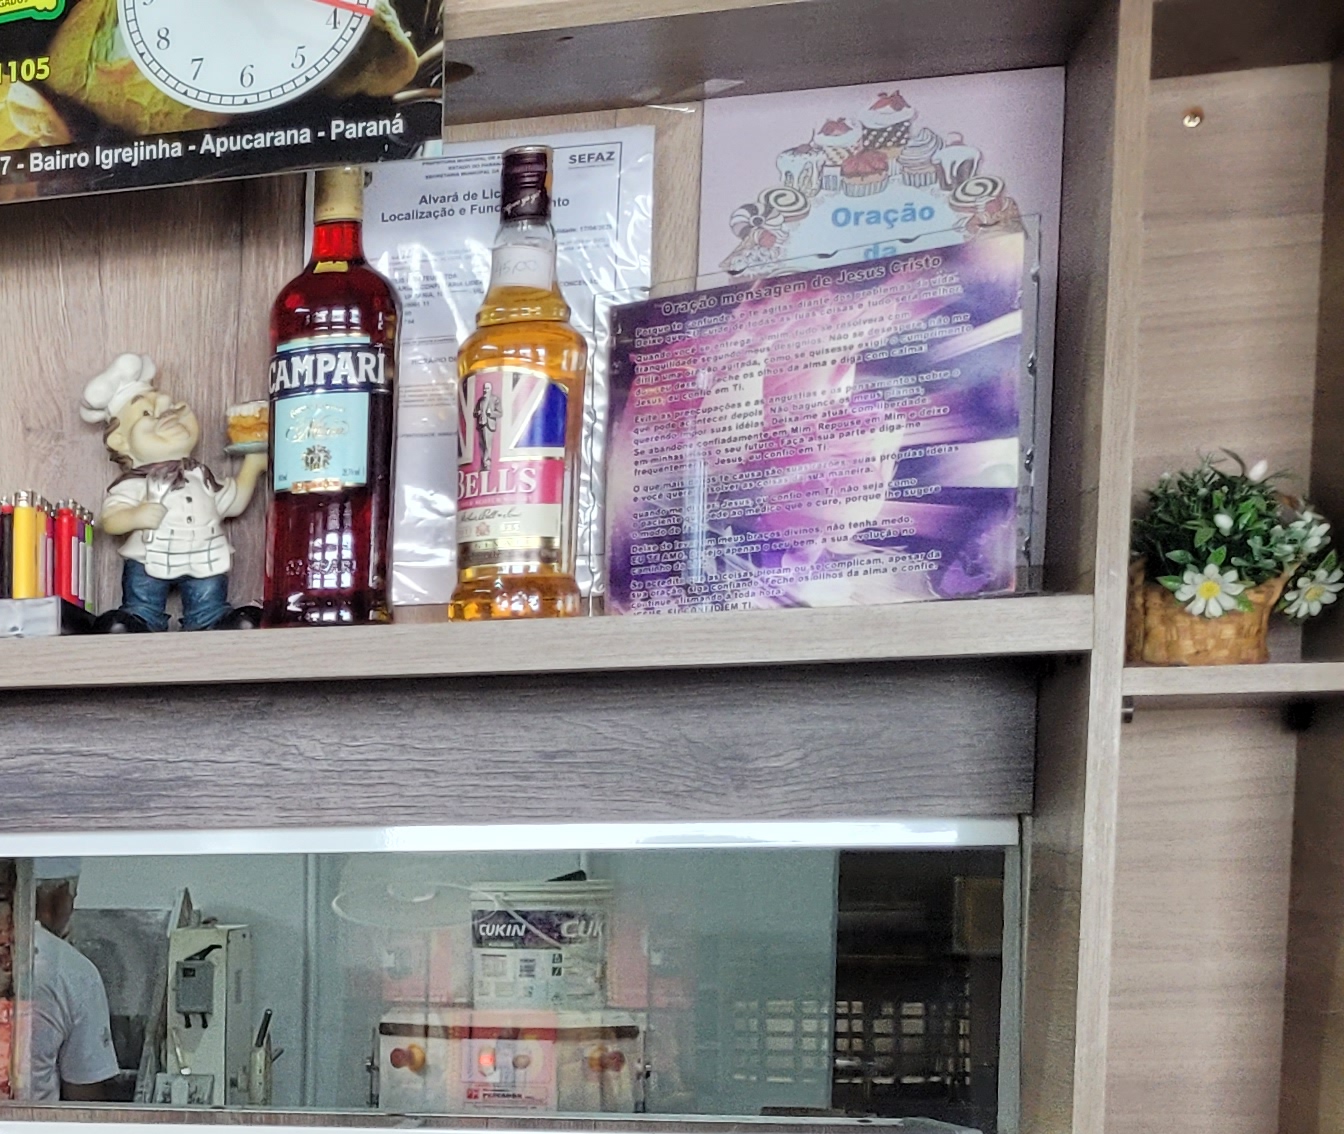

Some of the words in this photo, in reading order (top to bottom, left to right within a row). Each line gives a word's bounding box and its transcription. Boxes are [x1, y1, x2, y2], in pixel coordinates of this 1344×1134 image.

[324, 7, 341, 30] 4
[156, 26, 171, 50] 8
[290, 45, 307, 70] 5
[190, 57, 204, 81] 7
[239, 64, 255, 88] 6
[29, 149, 90, 173] Bairro
[95, 139, 182, 170] Igrejinha
[199, 125, 311, 157] Apucarana
[330, 112, 405, 140] Paraná
[568, 151, 616, 165] SEFAZ
[419, 191, 459, 206] Alvará
[463, 191, 478, 201] de
[381, 206, 455, 223] Localização
[831, 202, 935, 229] Oração
[864, 243, 897, 260] da
[662, 293, 716, 319] Oração
[721, 280, 806, 306] mensagem
[811, 273, 831, 288] de
[837, 264, 885, 284] Jesus
[889, 253, 941, 275] Cristo
[808, 342, 854, 359] quisesse
[802, 358, 827, 370] alma
[839, 353, 862, 366] diga
[268, 351, 386, 394] CAMPARI
[457, 466, 537, 500] BELL'S
[844, 491, 881, 504] porque
[848, 518, 878, 529] tenha
[478, 922, 526, 938] CUKIN
[562, 919, 605, 938] CUK
